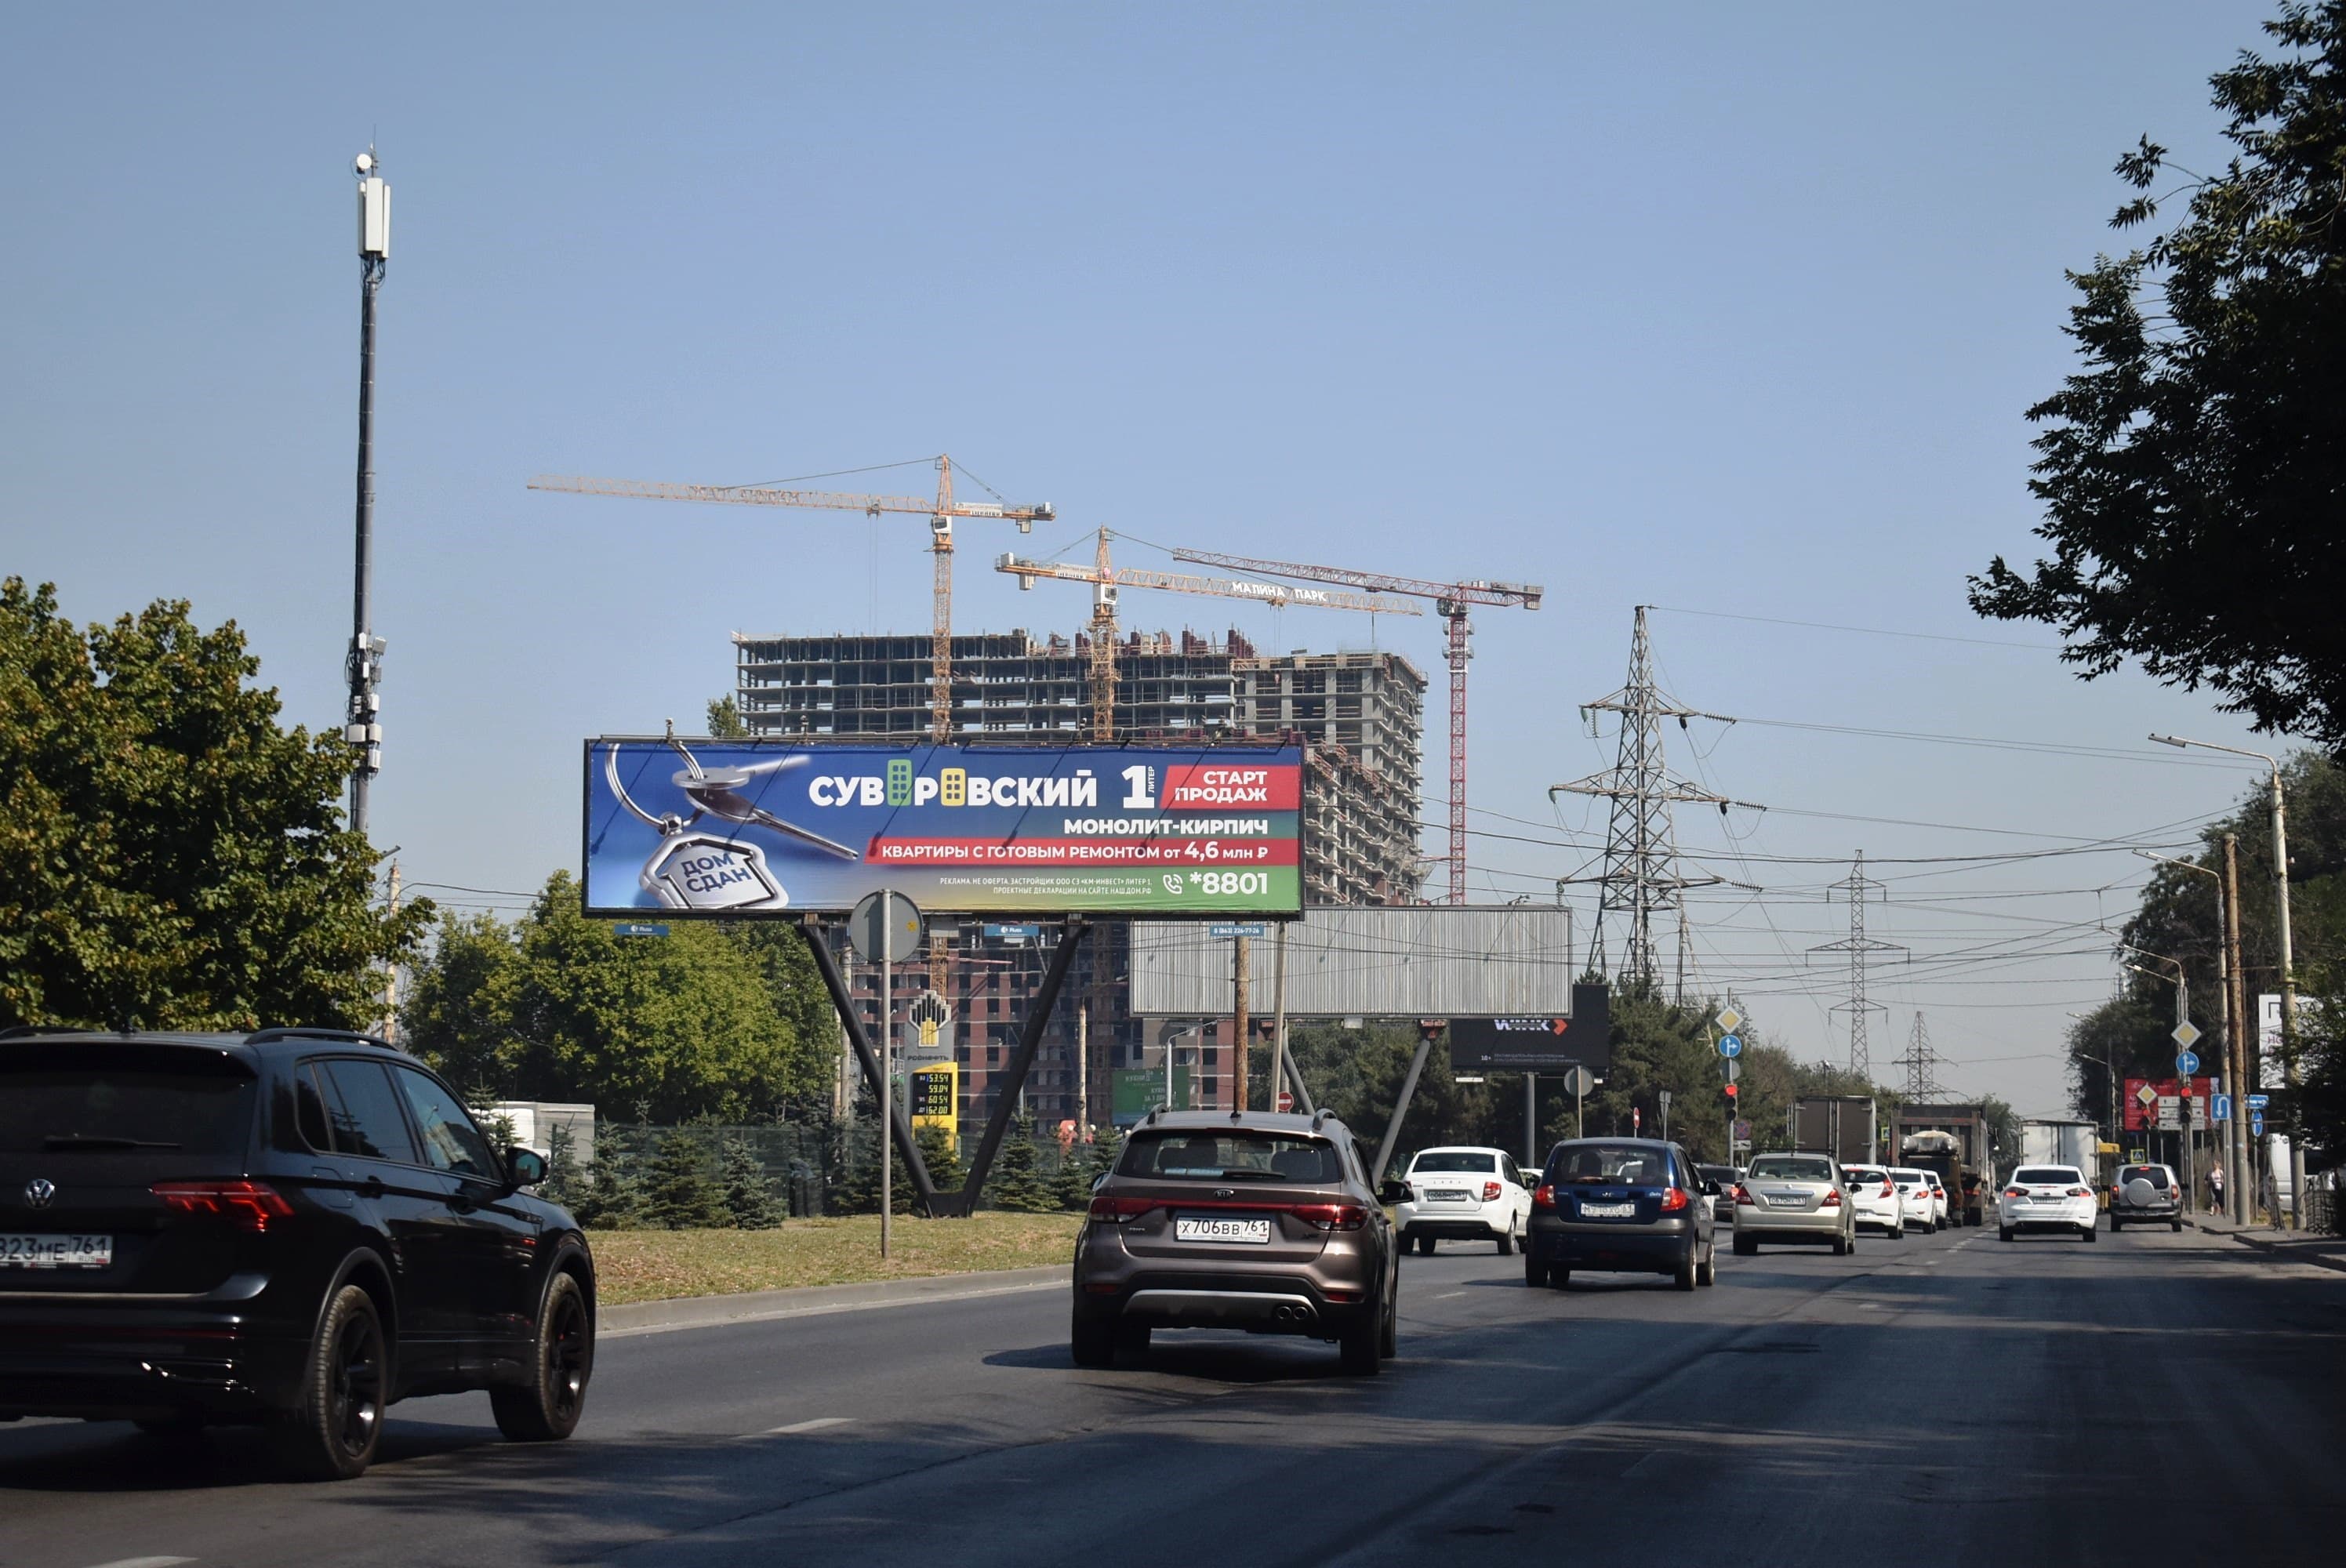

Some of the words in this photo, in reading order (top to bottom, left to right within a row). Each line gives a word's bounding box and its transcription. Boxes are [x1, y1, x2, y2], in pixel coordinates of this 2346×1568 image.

[1232, 582, 1286, 597] МАЛИНА
[1295, 589, 1327, 601] ПАРК
[1121, 765, 1155, 809] 1
[1203, 771, 1268, 785] СТАРТ
[1175, 786, 1268, 804] ПРОДАЖ
[1064, 818, 1269, 835] МОНОЛИТ-КИРПИЧ
[882, 845, 969, 858] КВАРТИРЫ
[972, 845, 983, 858] С
[987, 845, 1065, 858] ГОТОВЫМ
[1070, 847, 1160, 859] РЕМОНТОМ
[1164, 849, 1181, 858] от
[1184, 840, 1220, 862] 4,6
[1222, 850, 1253, 859] млн
[681, 852, 735, 878] ДОМ
[686, 867, 753, 892] СДАН
[1011, 877, 1055, 885] ЗАСТРОЙЩИК
[1182, 1220, 1240, 1235] Х706ВВ
[1243, 1221, 1268, 1232] 761
[72, 1236, 107, 1254] 761
